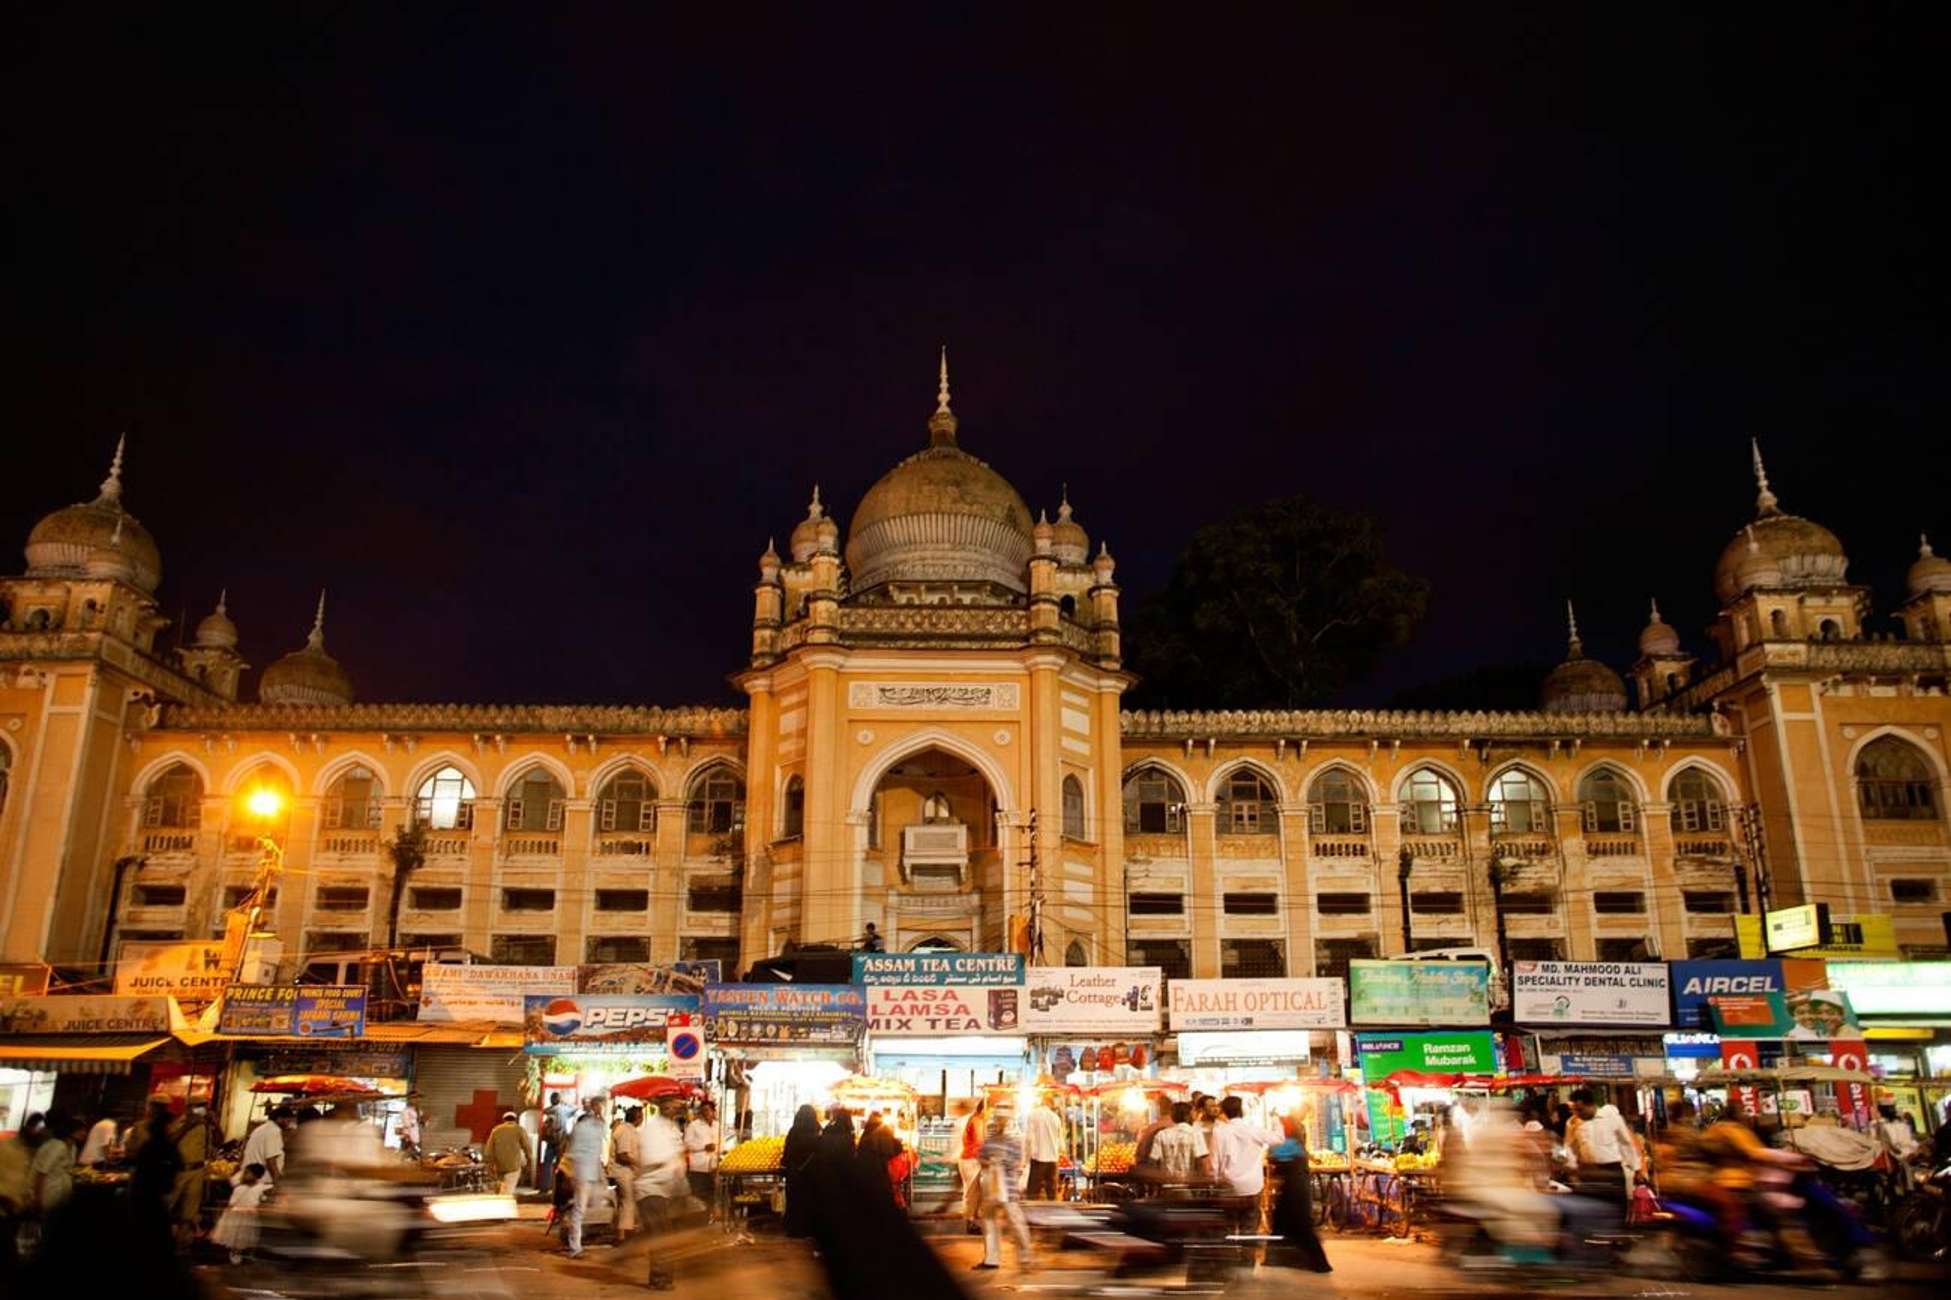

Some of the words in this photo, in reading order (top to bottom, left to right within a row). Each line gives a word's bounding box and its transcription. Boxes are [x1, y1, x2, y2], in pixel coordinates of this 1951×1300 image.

[863, 958, 915, 972] ASSAM
[920, 958, 951, 972] TEA
[955, 958, 1016, 972] CENTRE
[1541, 964, 1561, 974] MD.
[1564, 964, 1619, 974] MAHMOOD
[1623, 965, 1640, 975] ALI
[1070, 973, 1116, 988] Leather
[1517, 976, 1580, 986] SPECIALITY
[1584, 977, 1625, 987] DENTAL
[1629, 978, 1665, 988] CLINIC
[1682, 976, 1778, 995] AIRCEL
[225, 988, 274, 1001] PRINCE
[883, 989, 958, 1001] LASA
[1066, 990, 1121, 1007] Cottage
[1173, 986, 1238, 1013] FARAH
[1244, 991, 1327, 1011] OPTICAL
[870, 1004, 969, 1016] LAMSA
[865, 1018, 911, 1030] MIX
[925, 1018, 980, 1030] TEA
[1422, 1043, 1470, 1053] Ramzan
[1424, 1056, 1476, 1067] Mubarak
